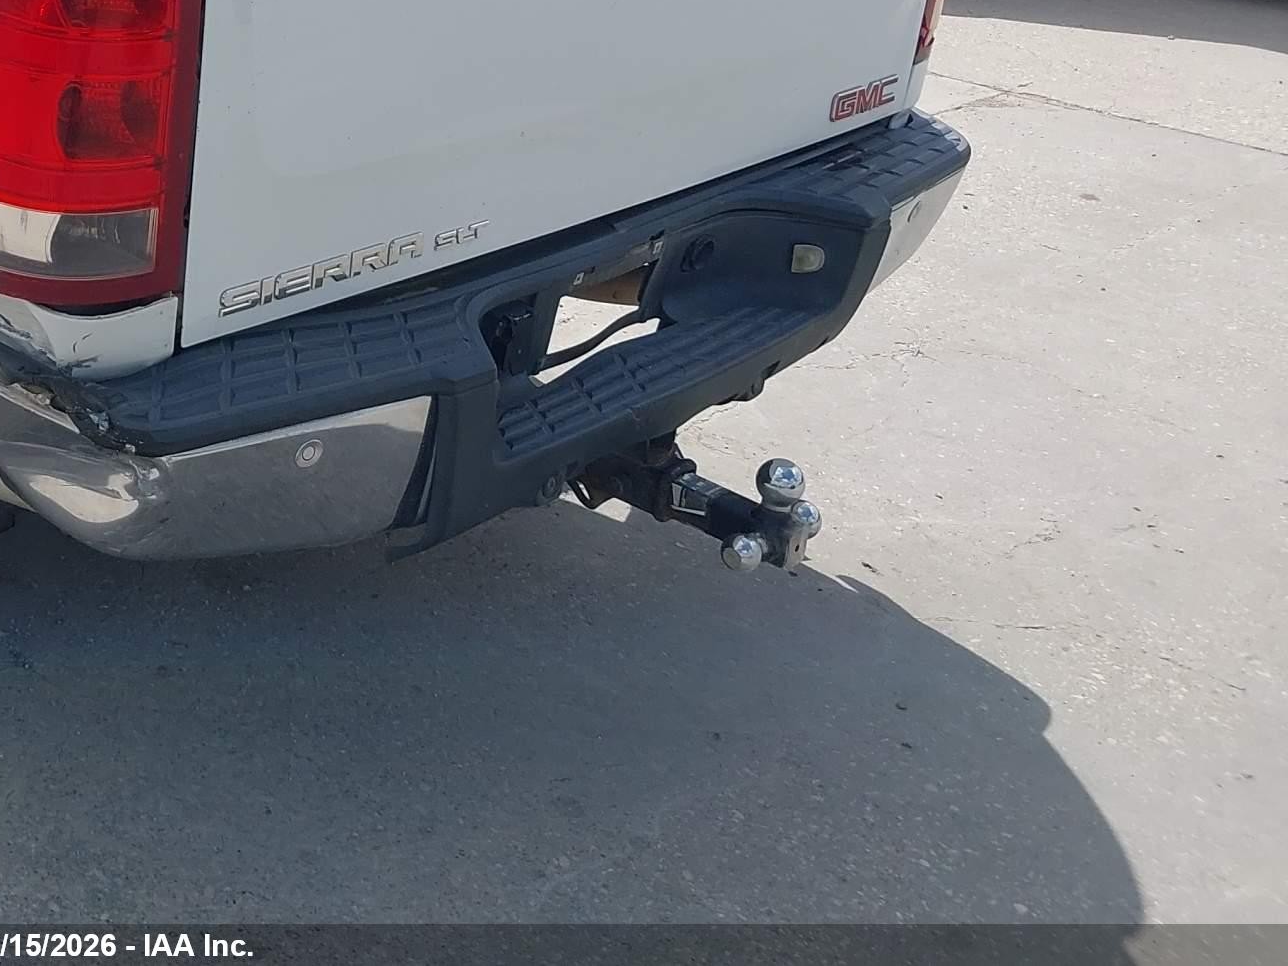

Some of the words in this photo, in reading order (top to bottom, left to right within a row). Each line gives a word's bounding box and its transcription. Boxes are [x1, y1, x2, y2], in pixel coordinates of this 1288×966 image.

[829, 73, 899, 122] GMC
[218, 231, 424, 318] SIERRA
[433, 219, 490, 252] SLT
